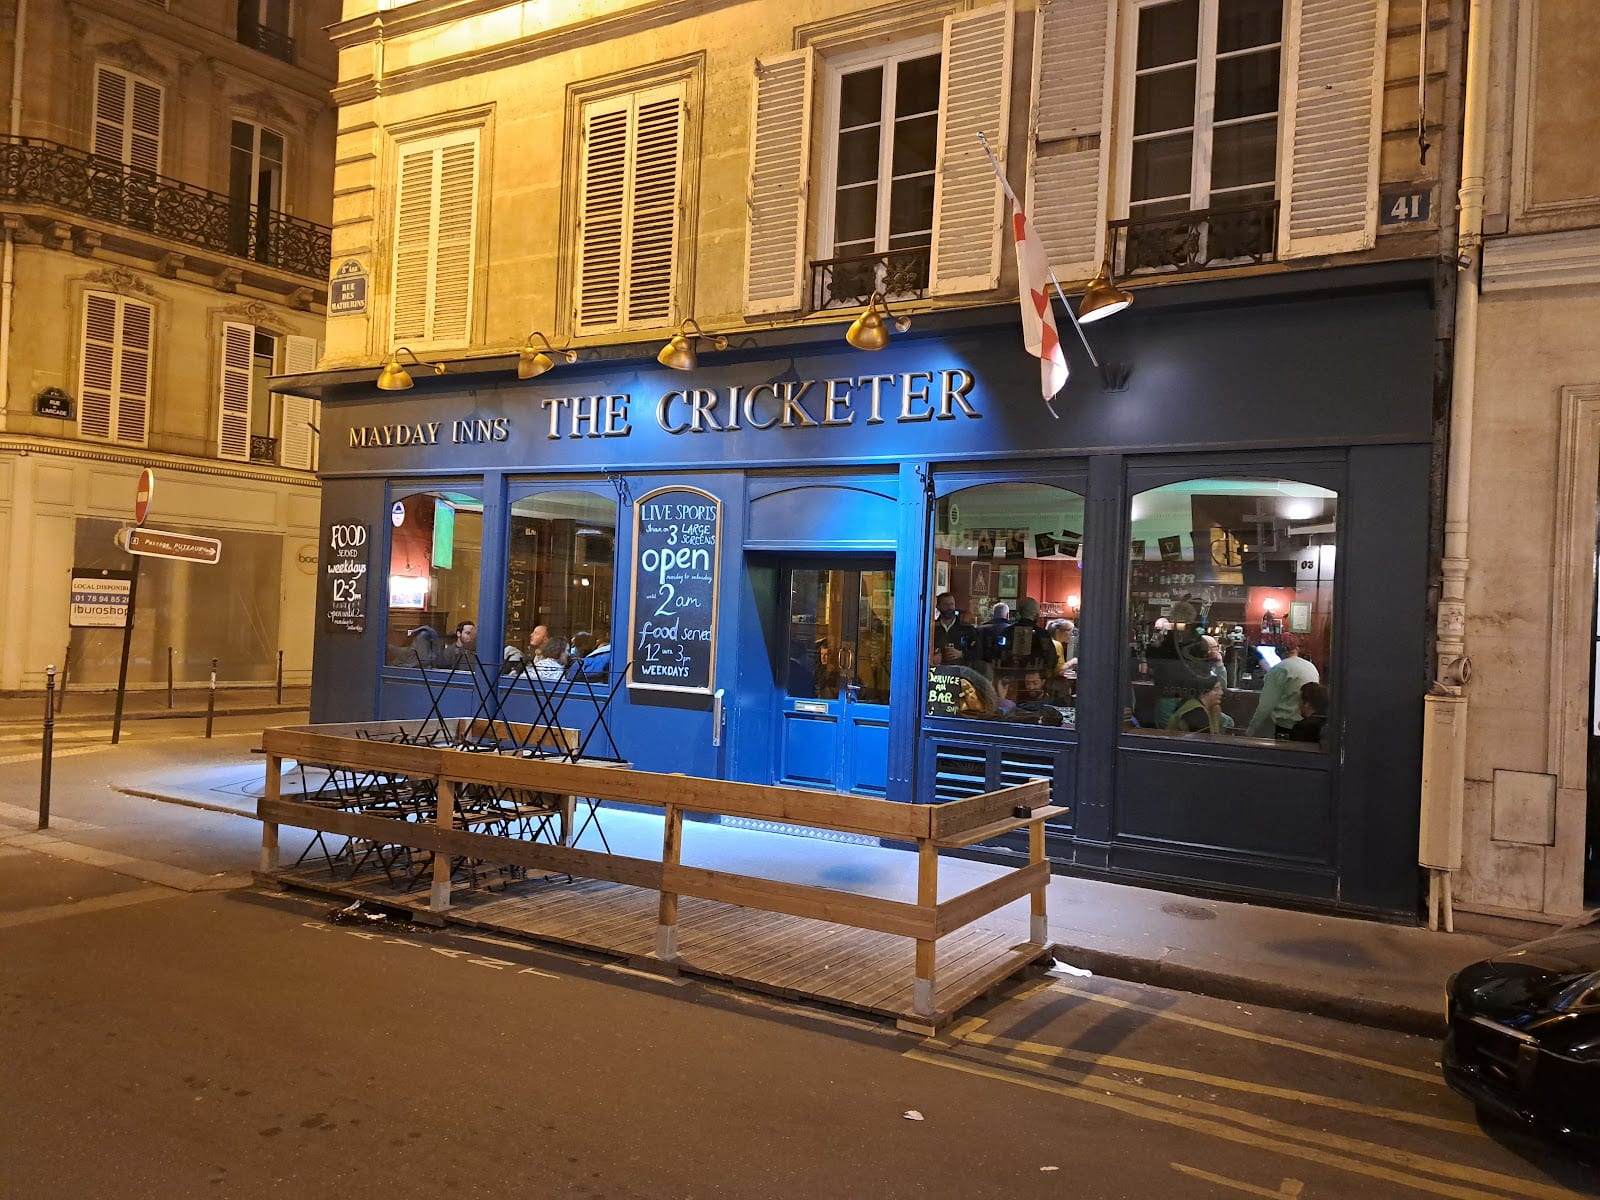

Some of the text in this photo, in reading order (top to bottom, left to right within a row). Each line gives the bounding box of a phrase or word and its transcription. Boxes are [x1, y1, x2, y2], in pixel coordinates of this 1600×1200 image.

[1390, 194, 1420, 219] 41
[341, 283, 356, 292] RUE
[331, 299, 365, 310] MATHURINS
[342, 292, 355, 301] DES
[349, 368, 983, 449] MAYDAY INNS THE CRICKETER
[641, 504, 717, 521] LIVE SPORTS
[331, 524, 366, 550] FOOD
[667, 525, 678, 546] 3
[681, 524, 711, 535] LARGE
[681, 534, 716, 546] SCREENS
[337, 549, 358, 557] SERVED
[327, 559, 367, 580] weekdays
[642, 547, 710, 585] open
[638, 616, 713, 650] food served
[645, 643, 661, 661] 12
[641, 665, 690, 678] WEEKDAYS
[928, 690, 955, 704] BAR
